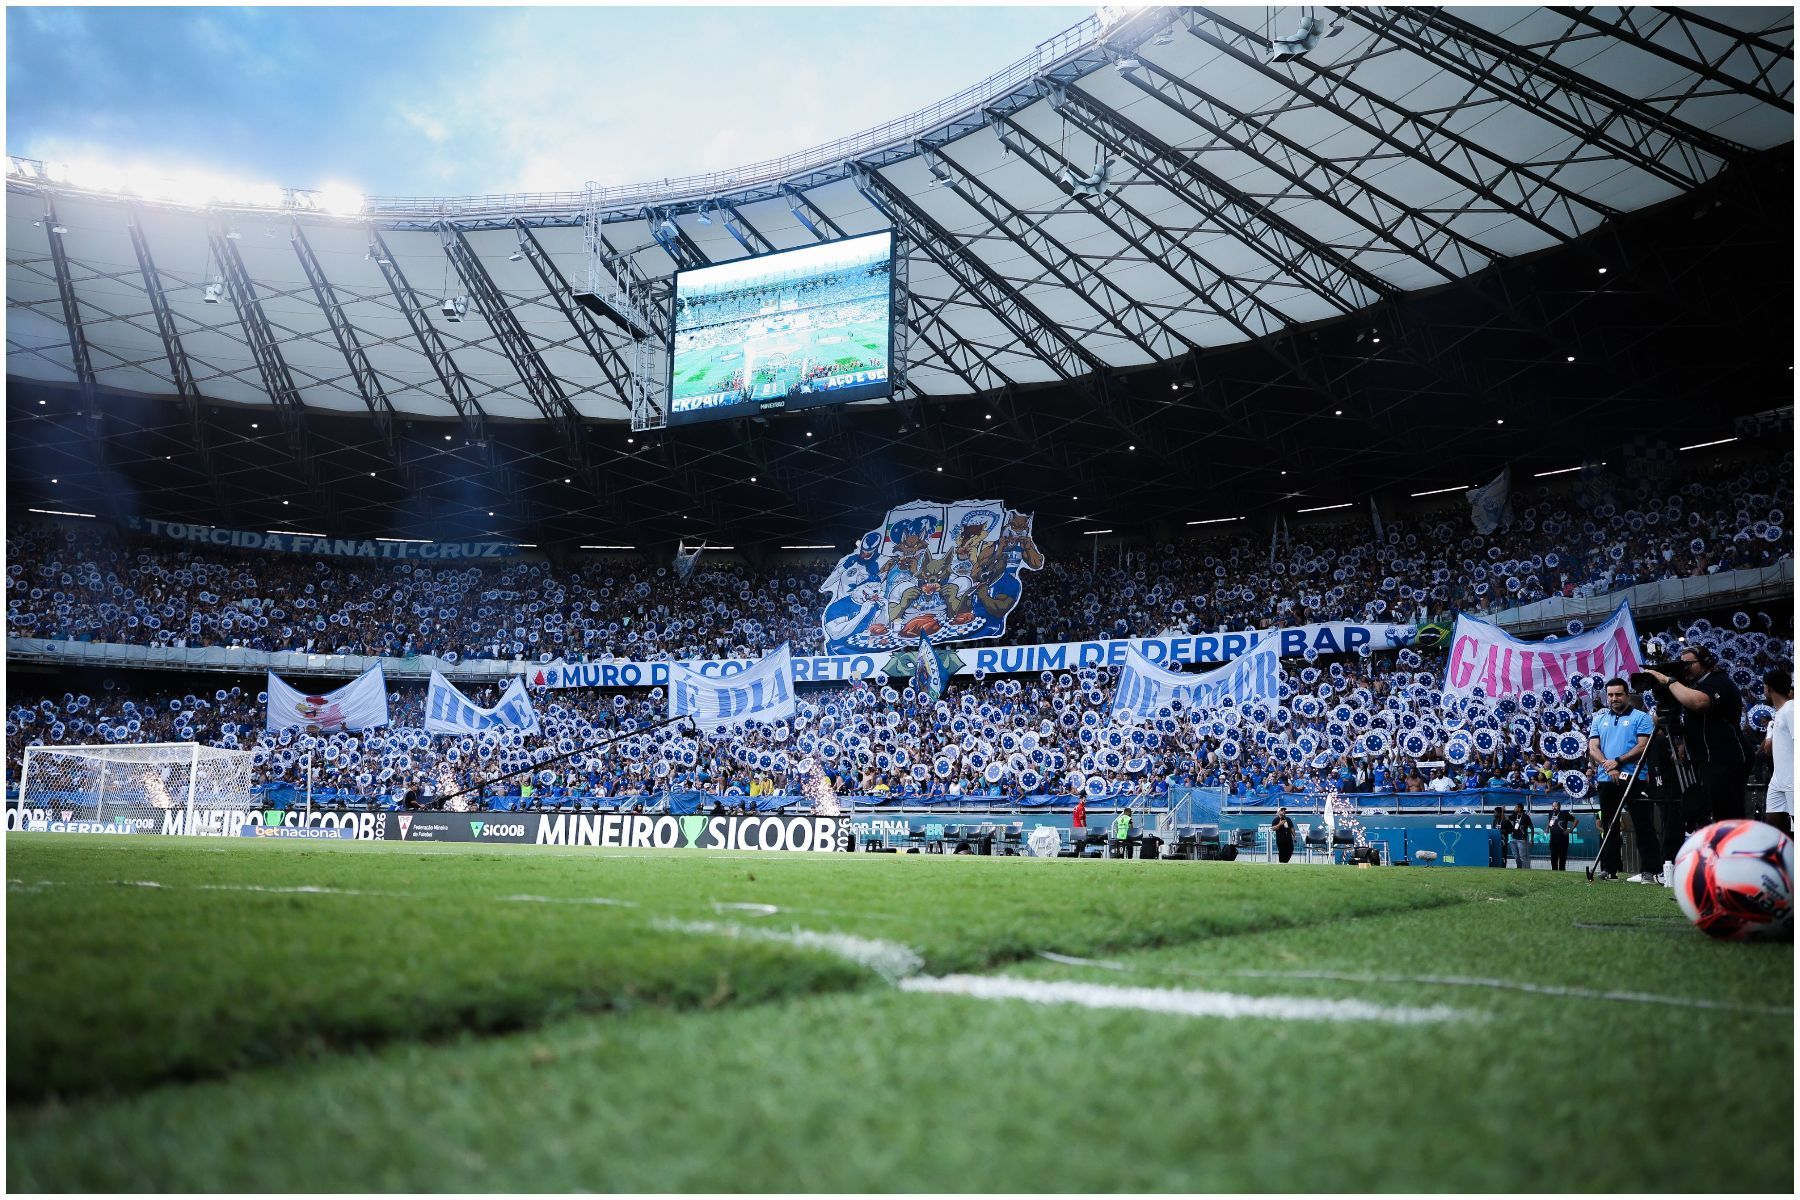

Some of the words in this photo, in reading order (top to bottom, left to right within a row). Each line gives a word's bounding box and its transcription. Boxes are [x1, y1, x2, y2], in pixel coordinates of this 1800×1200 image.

[145, 518, 286, 552] TORCIDA
[291, 535, 501, 560] FANATI-CRUZ
[562, 663, 642, 687] MURO
[977, 645, 1067, 673] RUIM
[1078, 641, 1129, 668] DE
[1141, 627, 1372, 664] DERRBAR
[1450, 626, 1640, 699] GALINHA
[714, 668, 787, 718] DIA
[1115, 664, 1160, 717] DE
[50, 822, 131, 834] GERDAU
[255, 825, 342, 839] betnacional
[483, 824, 525, 837] SICOOB
[535, 814, 679, 849] MINEIRO
[706, 816, 837, 852] SICOOB
